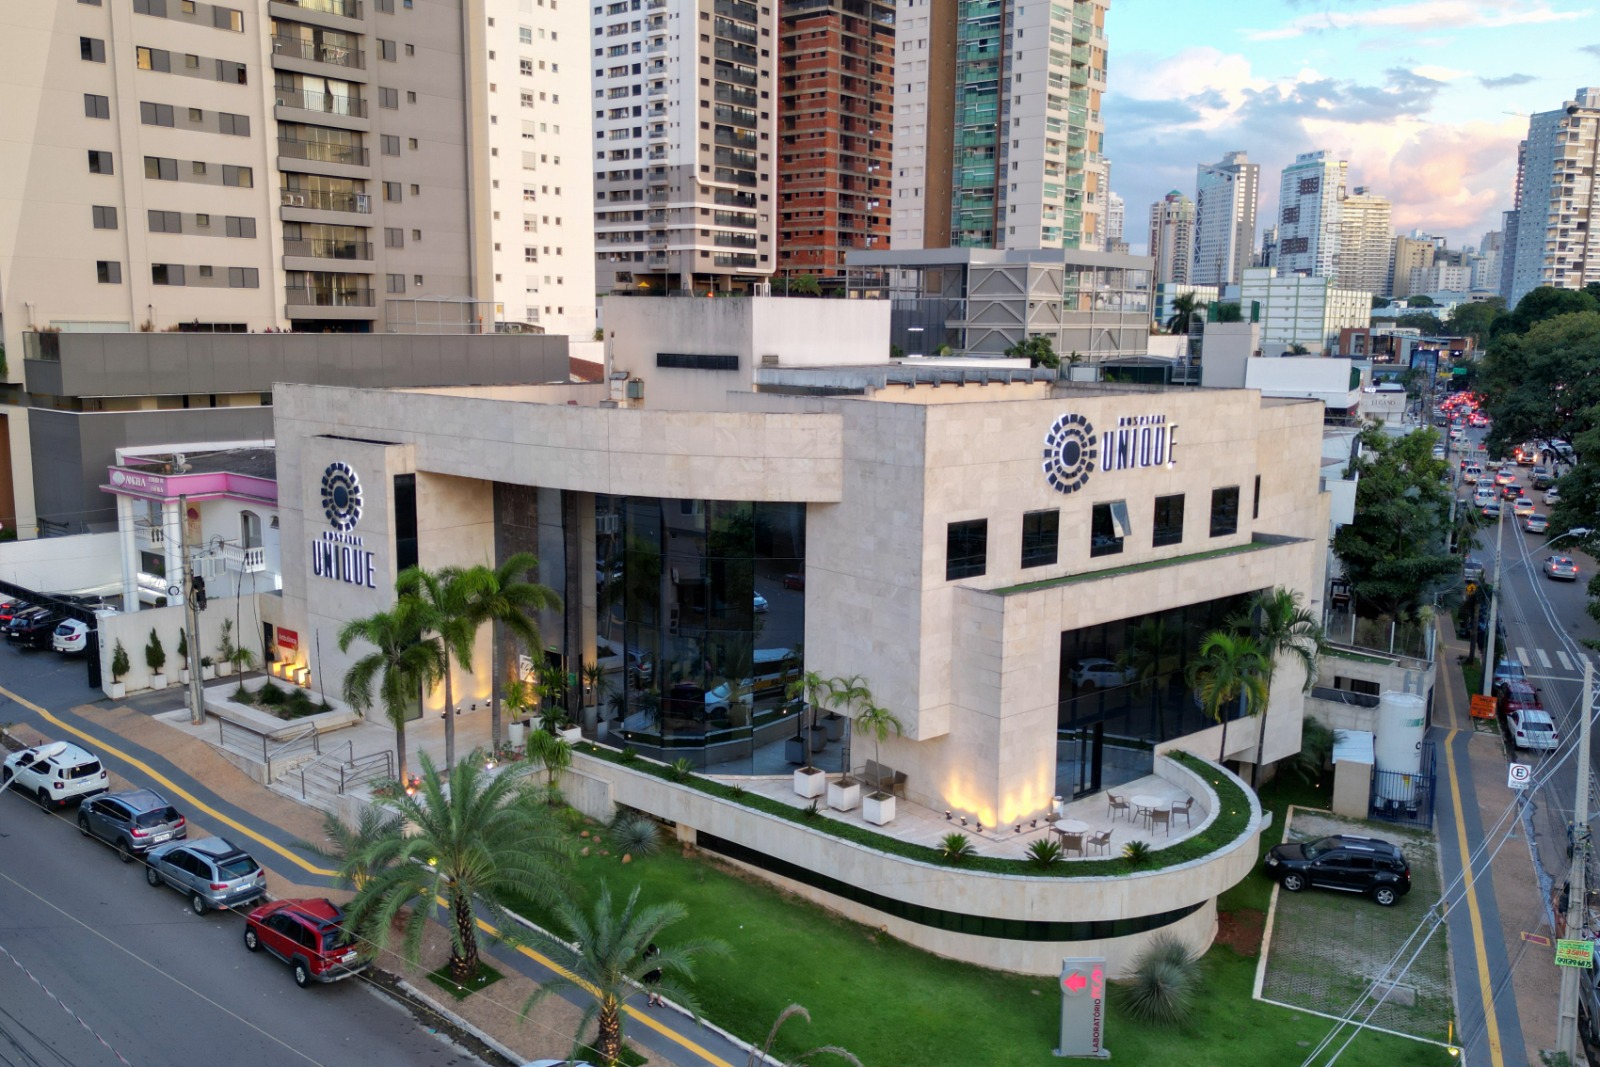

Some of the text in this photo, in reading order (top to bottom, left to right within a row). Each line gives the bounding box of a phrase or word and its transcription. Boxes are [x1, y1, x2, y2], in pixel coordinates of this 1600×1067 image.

[1118, 415, 1165, 426] HOSPITAL
[1101, 424, 1178, 471] UNIQUE
[323, 531, 362, 546] HOSPITAL
[313, 540, 376, 588] UNIQUE
[1516, 768, 1524, 777] E
[1092, 999, 1101, 1053] LABORATÓRIO
